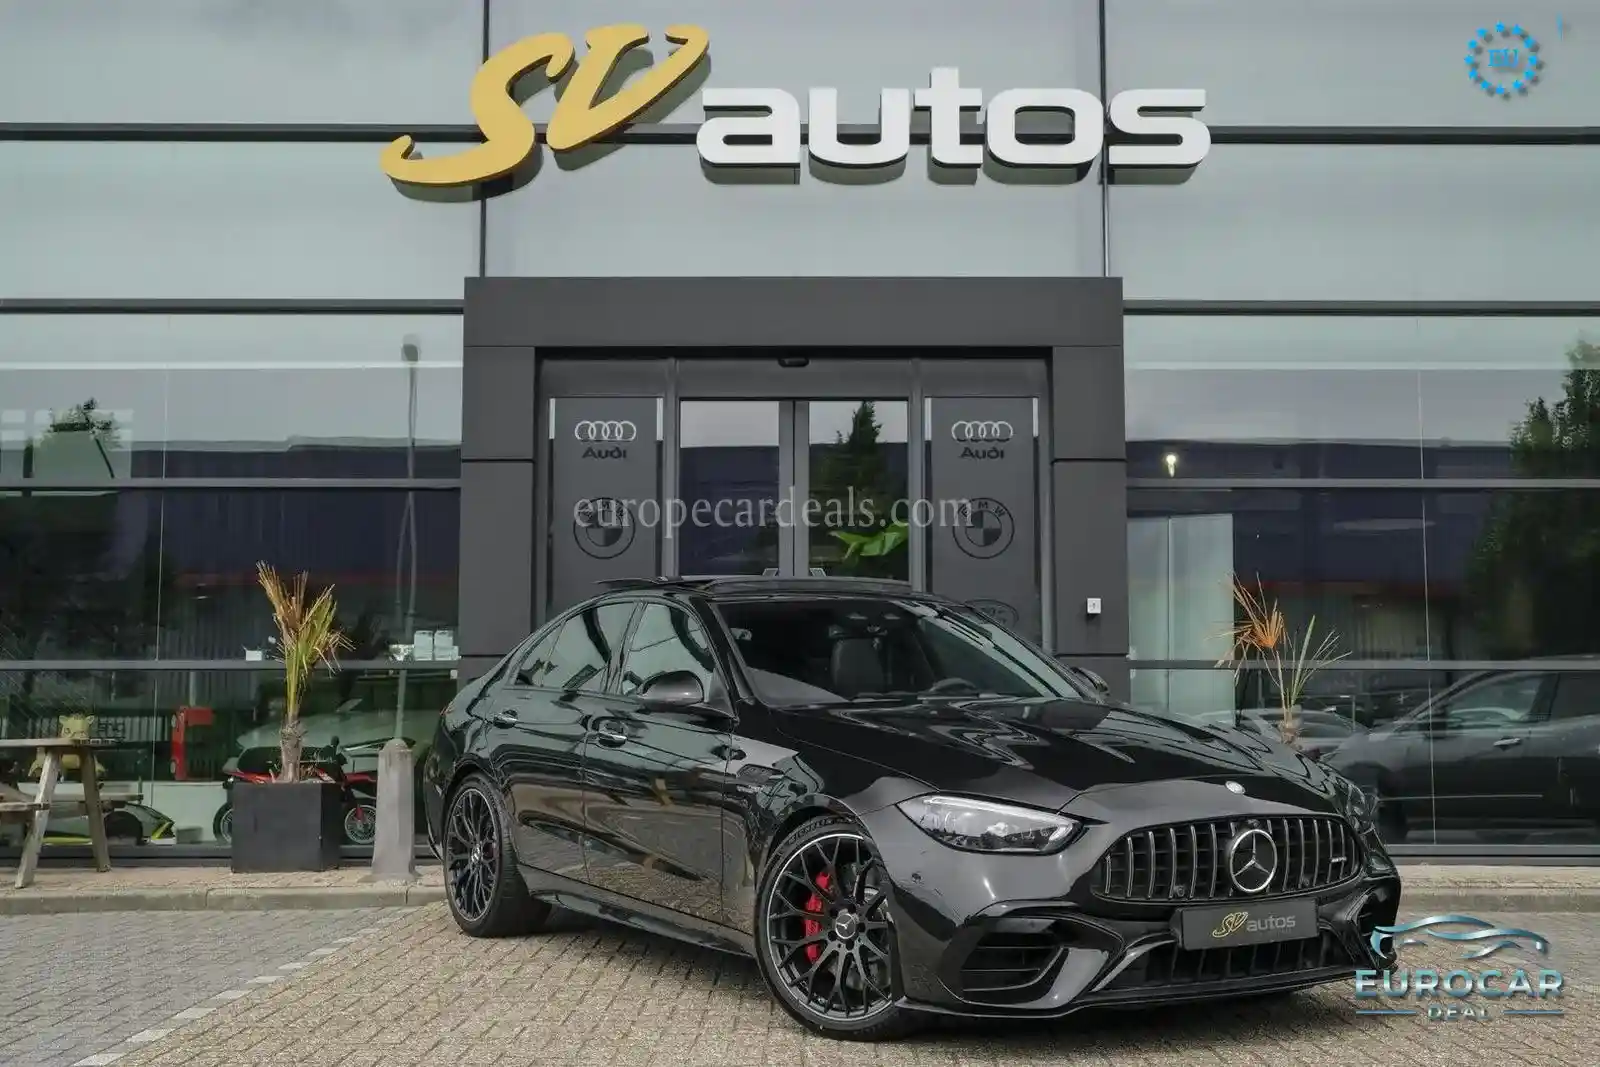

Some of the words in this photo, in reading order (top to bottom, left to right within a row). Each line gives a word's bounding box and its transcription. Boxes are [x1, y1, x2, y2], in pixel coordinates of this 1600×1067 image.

[696, 67, 1212, 168] autos
[582, 446, 627, 459] Audi
[961, 446, 1004, 459] Audi
[1246, 915, 1296, 932] autos
